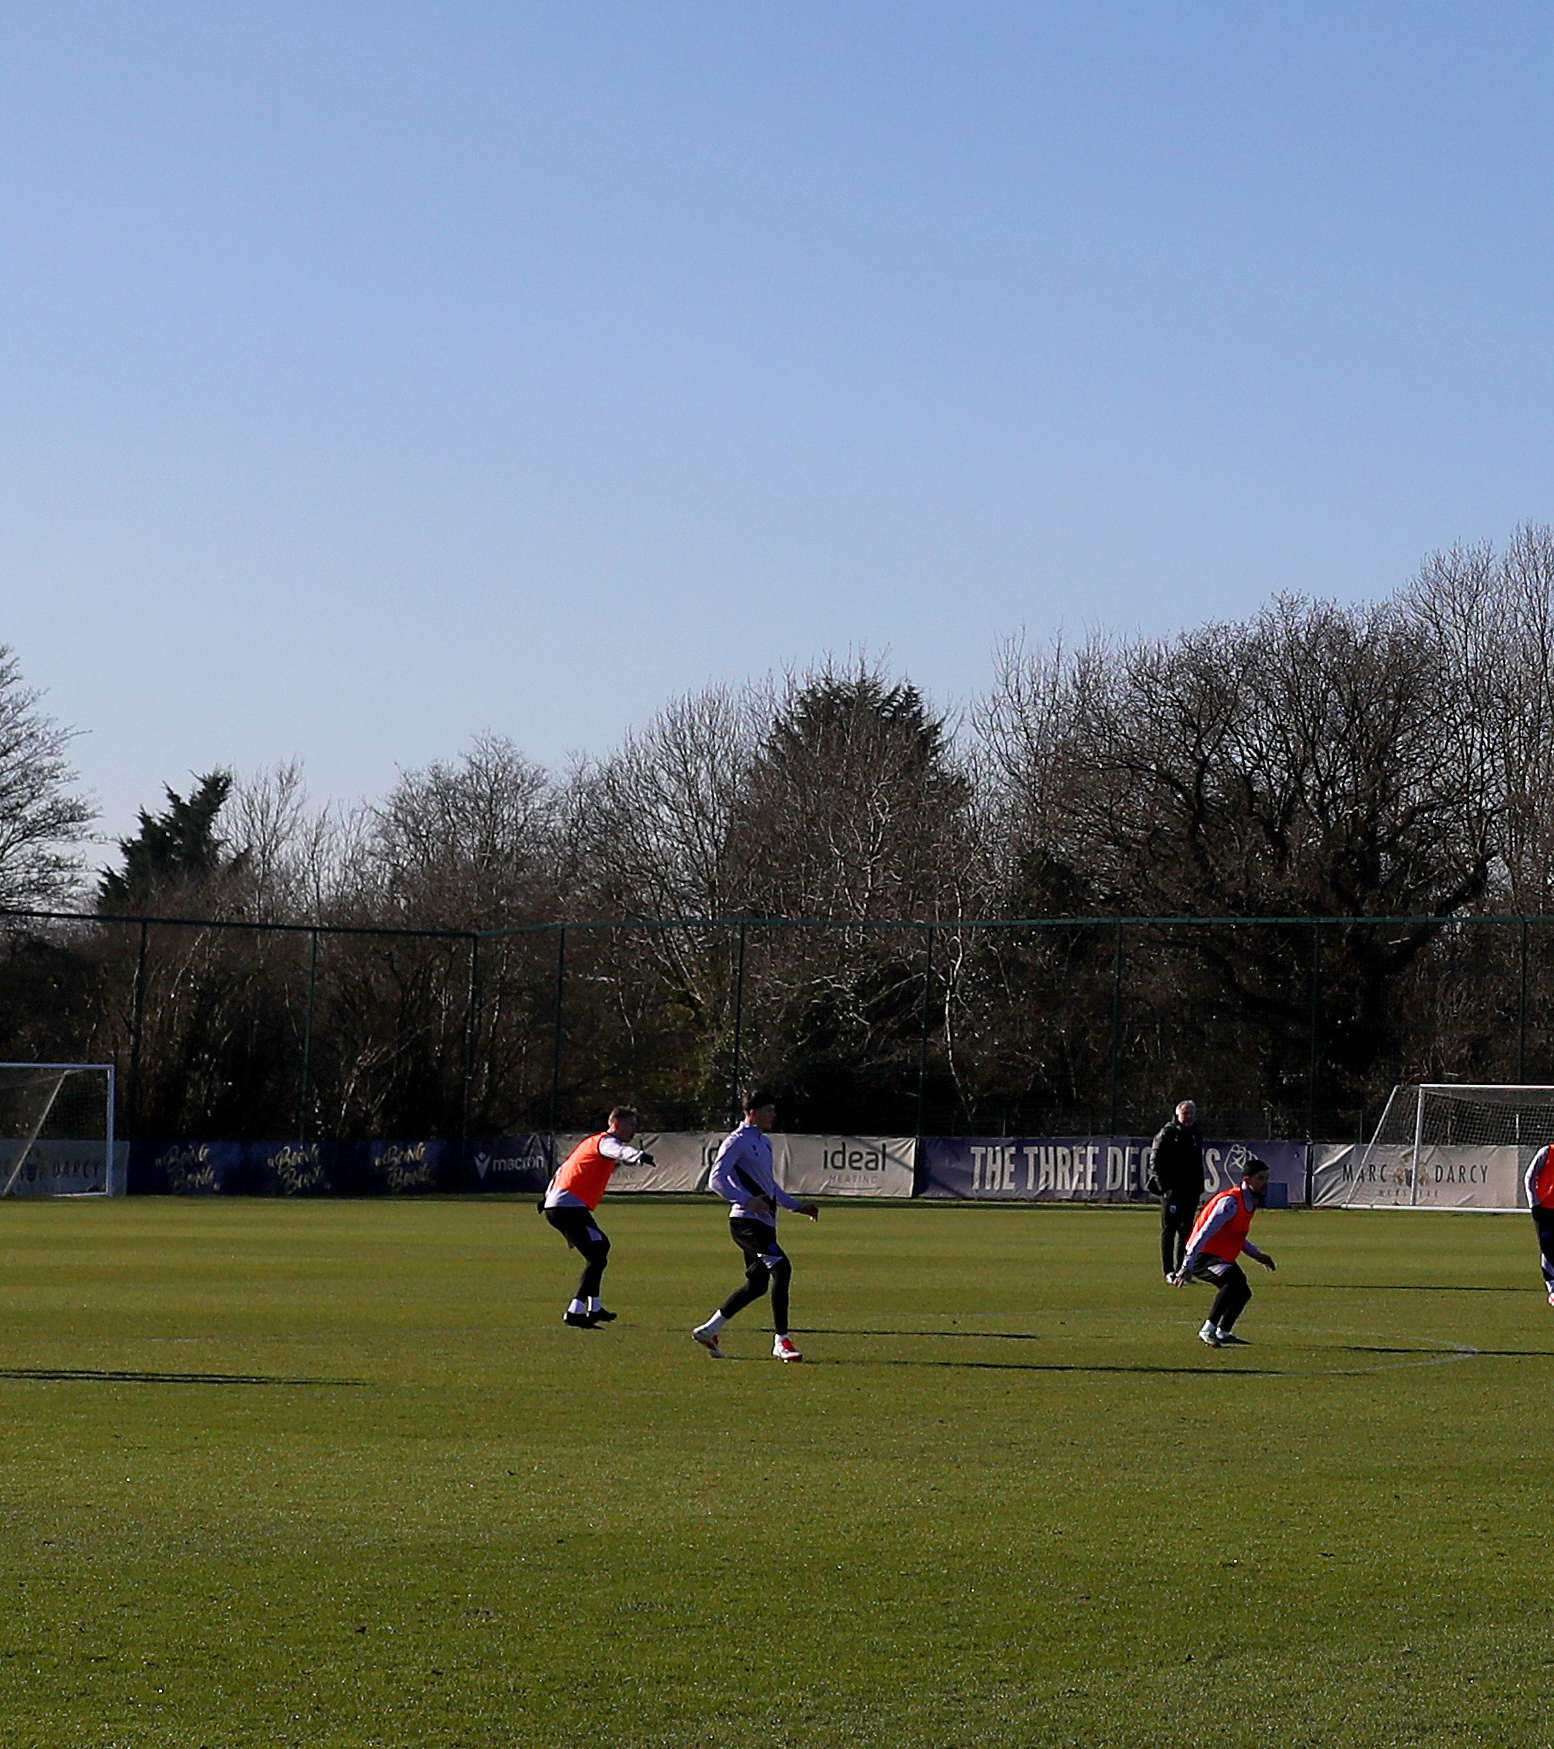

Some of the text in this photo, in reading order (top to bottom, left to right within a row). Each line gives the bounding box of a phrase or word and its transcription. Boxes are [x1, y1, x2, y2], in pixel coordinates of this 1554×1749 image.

[492, 1155, 545, 1172] macron
[823, 1141, 886, 1171] ideal
[970, 1145, 1017, 1191] THE
[1023, 1145, 1100, 1192] THREE
[1342, 1163, 1488, 1184] MARC DARCY
